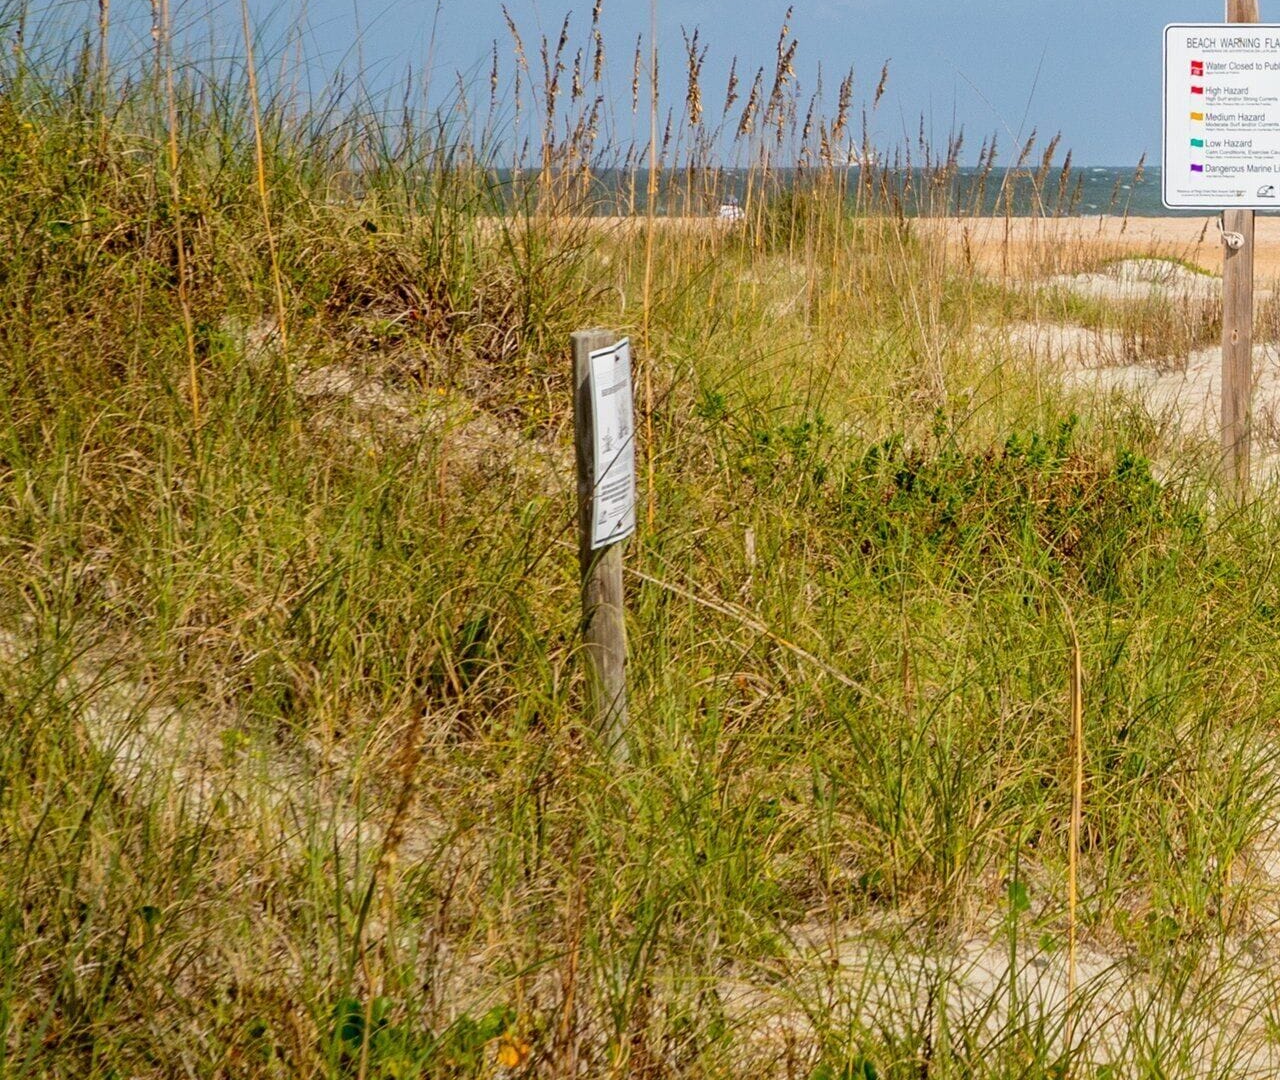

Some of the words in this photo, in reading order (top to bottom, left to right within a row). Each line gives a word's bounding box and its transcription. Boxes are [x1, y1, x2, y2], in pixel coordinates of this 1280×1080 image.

[1186, 37, 1216, 49] BEACH
[1220, 37, 1260, 49] WARNING
[1206, 61, 1227, 70] Water
[1229, 62, 1254, 70] Closed
[1256, 62, 1262, 70] to
[1205, 87, 1222, 97] High
[1224, 86, 1249, 95] Hazard
[1205, 113, 1236, 121] Medium
[1238, 113, 1266, 121] Hazard
[1205, 139, 1221, 148] Low
[1224, 139, 1253, 148] Hazard
[1205, 164, 1245, 175] Dangerous
[1247, 164, 1272, 173] Marine
